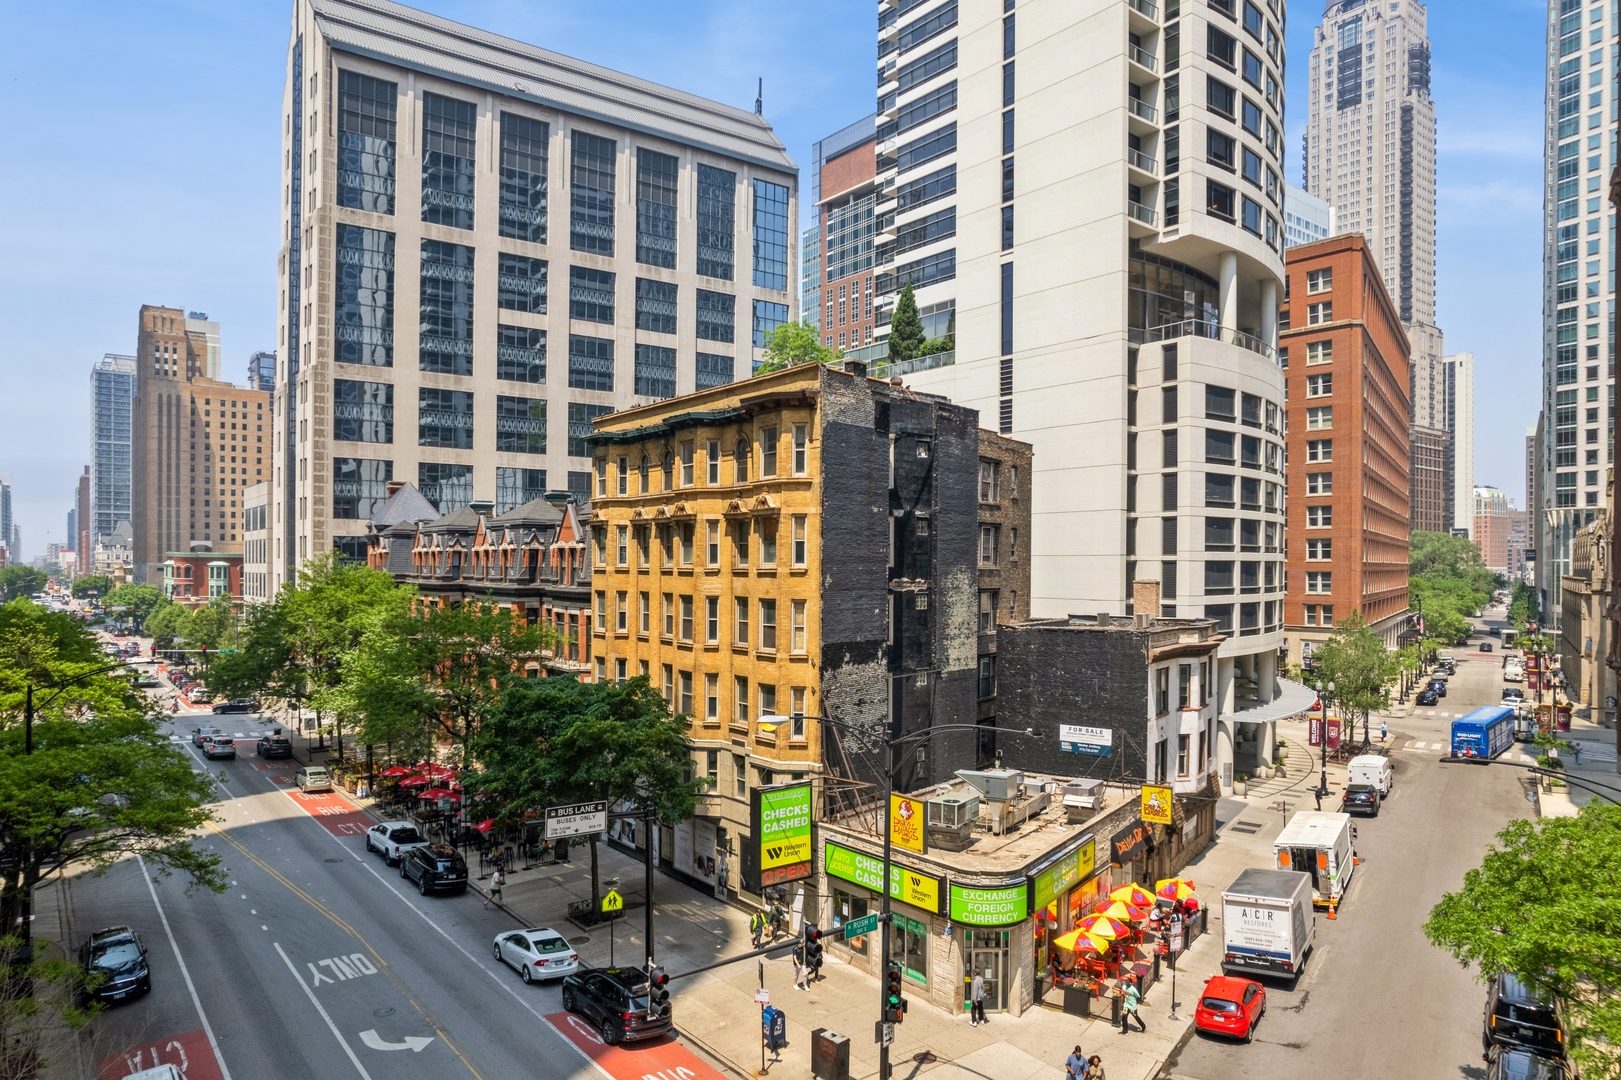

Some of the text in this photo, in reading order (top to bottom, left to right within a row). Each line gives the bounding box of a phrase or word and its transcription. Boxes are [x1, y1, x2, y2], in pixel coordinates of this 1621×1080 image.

[316, 805, 348, 816] BUS
[558, 805, 596, 817] BUS LANE
[763, 804, 809, 821] CHECKS
[763, 817, 808, 833] CASHED
[784, 842, 806, 851] Western
[1115, 835, 1136, 855] DEVIL
[784, 850, 800, 858] Union
[833, 852, 850, 863] AUTO
[762, 862, 809, 885] OPEN
[830, 861, 854, 875] LICENSE
[855, 856, 899, 881] CHECS
[855, 870, 899, 894] CASHD
[911, 893, 925, 903] Union
[912, 888, 932, 899] Western
[963, 890, 1018, 900] EXCHANGE
[968, 902, 1014, 913] FOREIGN
[962, 912, 1018, 923] CURRENCY
[853, 918, 868, 929] RUSH
[1244, 920, 1272, 928] RESTORES
[307, 953, 378, 987] ONLY
[897, 1010, 902, 1020] 9
